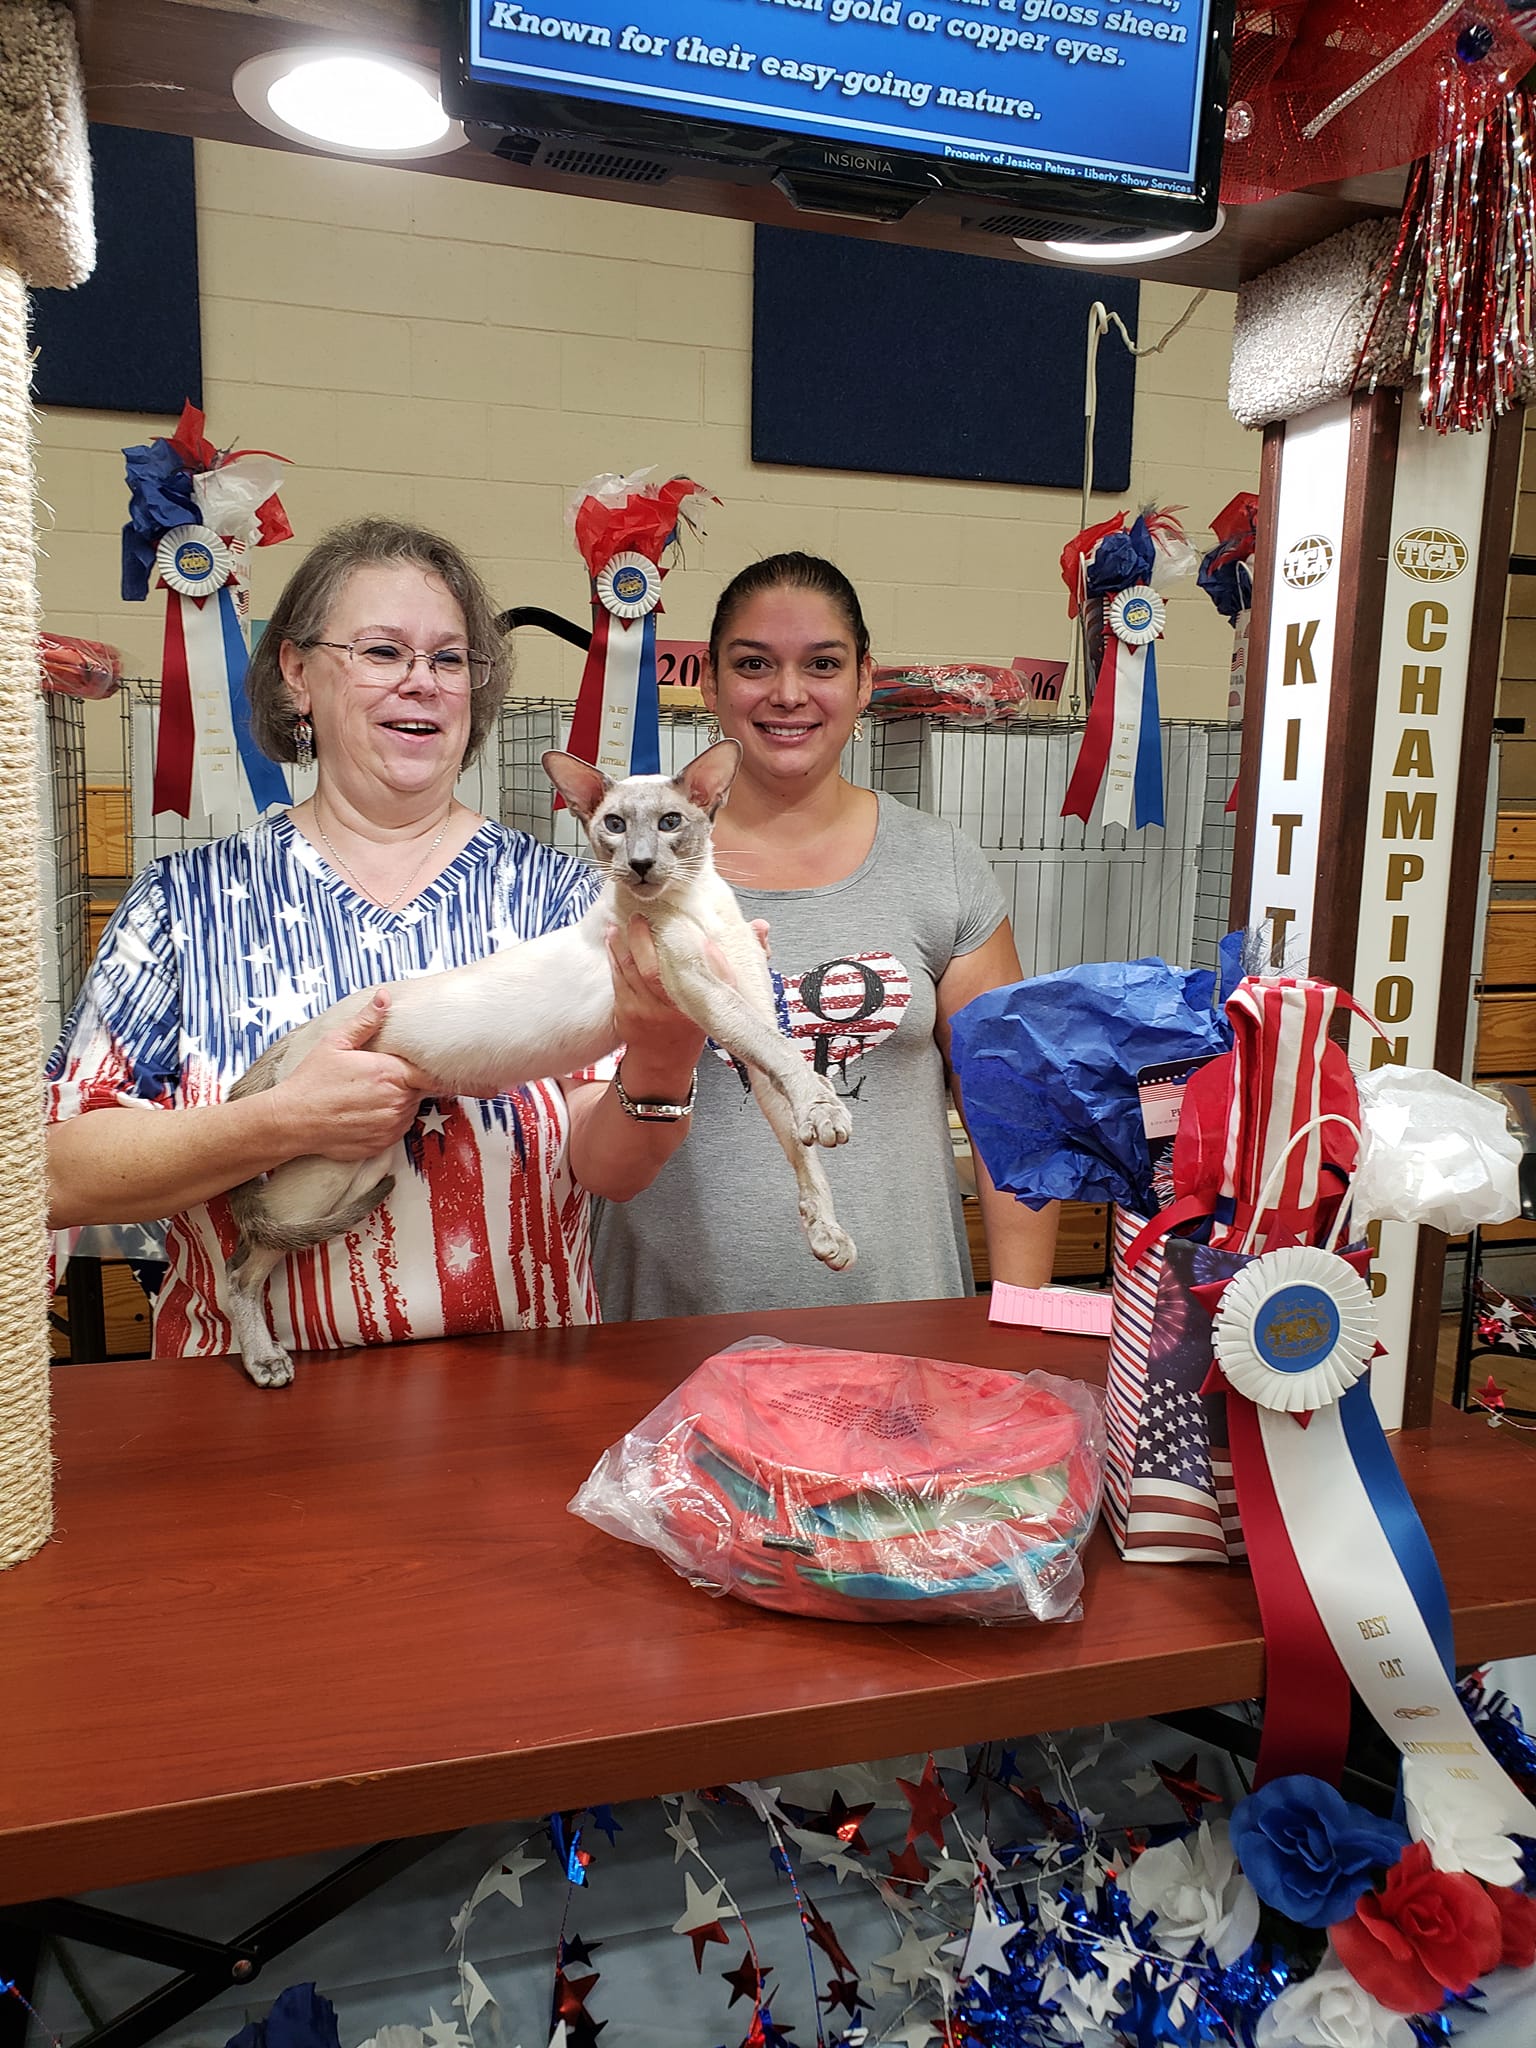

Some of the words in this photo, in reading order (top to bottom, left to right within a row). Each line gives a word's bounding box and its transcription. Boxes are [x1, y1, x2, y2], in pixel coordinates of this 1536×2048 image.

[830, 0, 900, 25] gold
[908, 11, 941, 32] or
[947, 19, 1050, 52] copper
[1055, 31, 1127, 66] eyes.
[1022, 0, 1099, 26] gloss
[1104, 10, 1187, 43] sheen
[489, 2, 611, 47] Known
[619, 25, 670, 56] for
[676, 36, 756, 72] their
[761, 53, 933, 107] easy-going
[937, 85, 1042, 120] nature.
[824, 151, 893, 173] INSIGNIA
[944, 145, 991, 163] Property
[993, 153, 1005, 165] of
[1006, 155, 1042, 170] Jessica
[1084, 167, 1118, 182] Liberty
[1121, 173, 1148, 187] Show
[1151, 178, 1191, 193] Services
[1402, 541, 1460, 570] TICA
[1357, 1615, 1391, 1640] BEST
[1378, 1658, 1405, 1679] CAT
